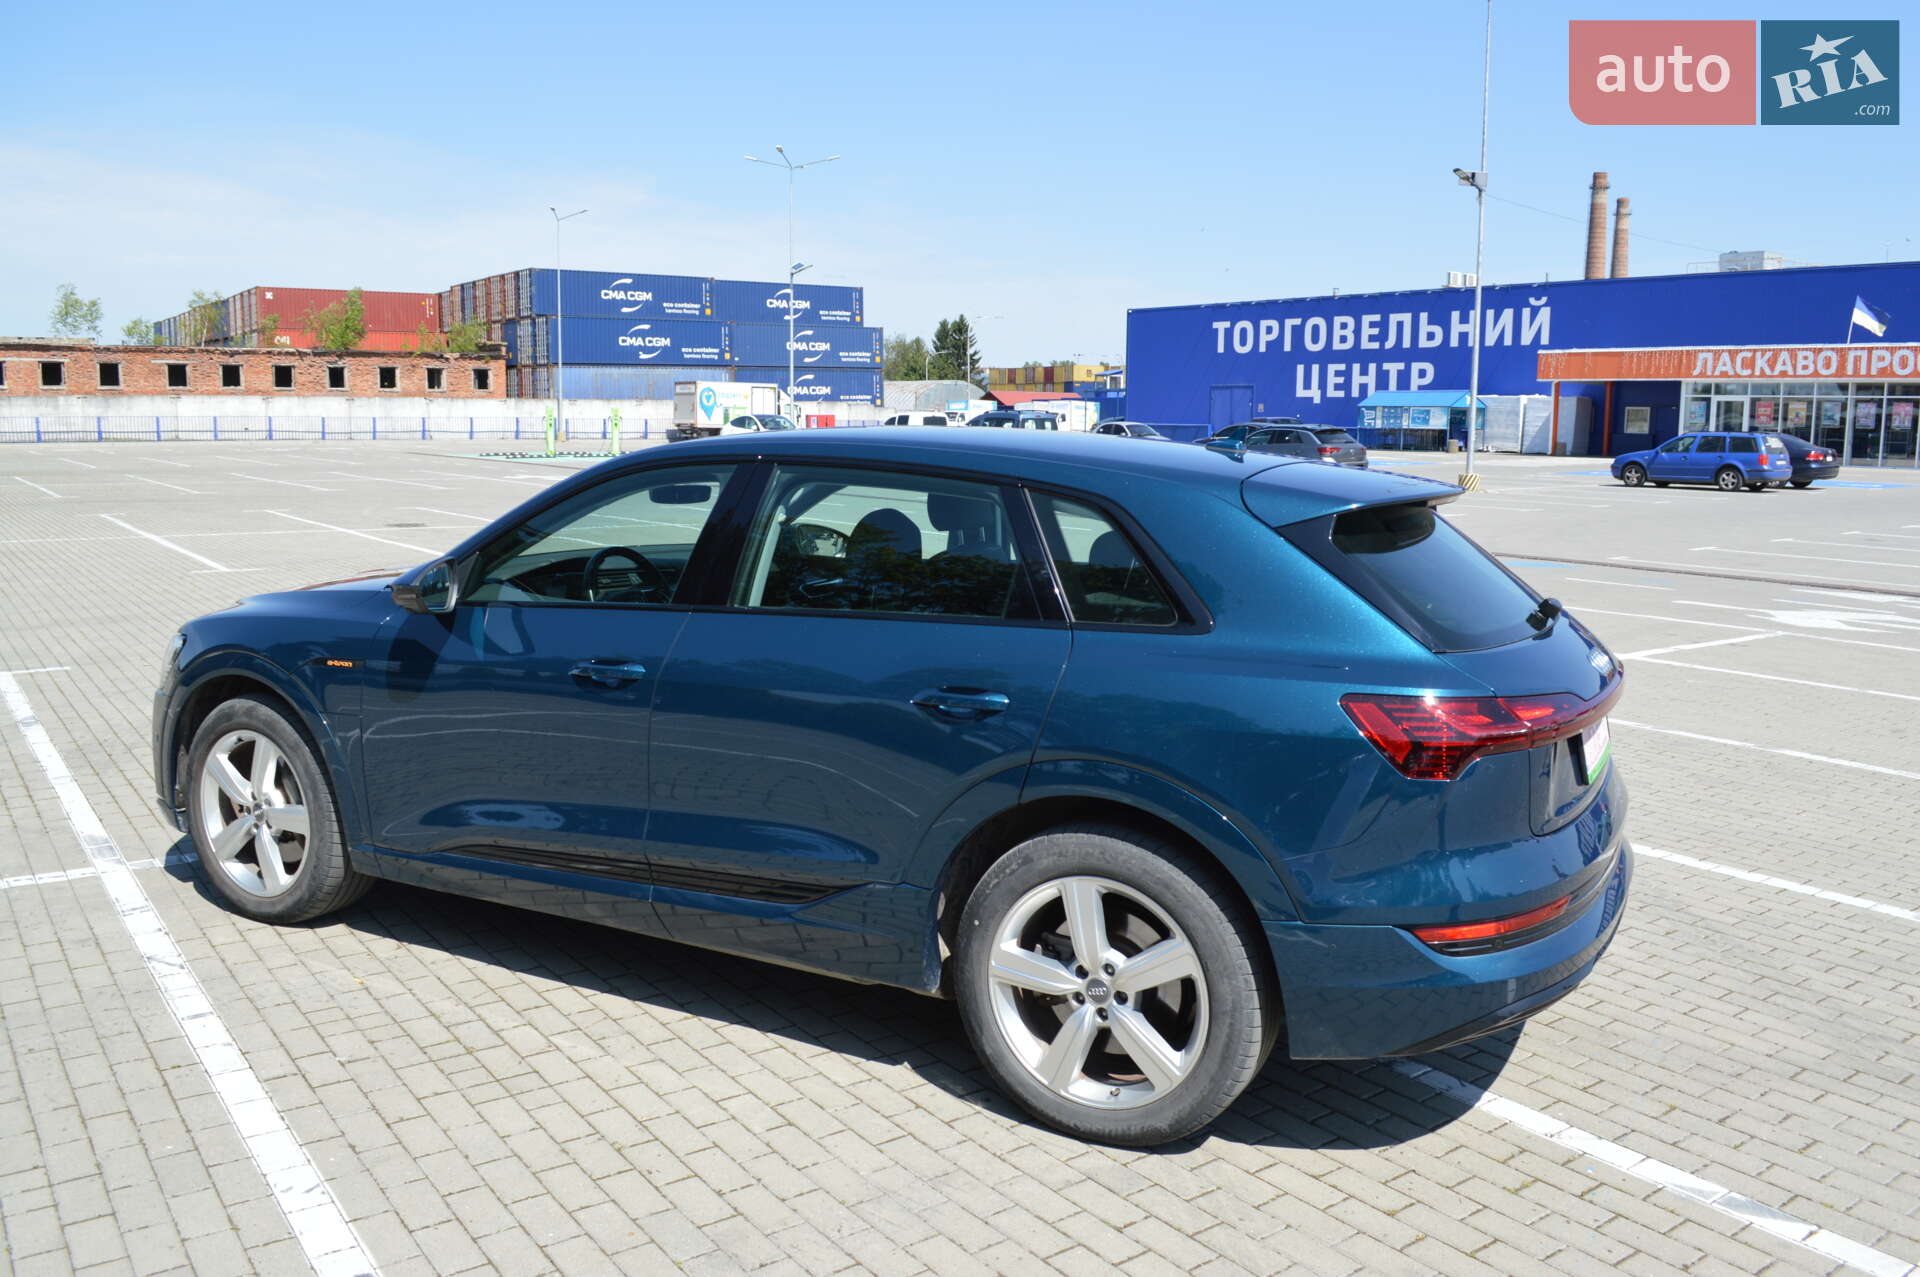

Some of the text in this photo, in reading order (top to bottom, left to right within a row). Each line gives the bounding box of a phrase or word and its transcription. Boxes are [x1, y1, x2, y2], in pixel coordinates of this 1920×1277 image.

[600, 289, 653, 302] CMA CGM
[766, 299, 811, 310] CMA CGM
[1212, 296, 1551, 354] ТОРГОВЕЛЬНИЙ
[618, 336, 671, 348] CMA CGM
[808, 342, 831, 352] CGM
[1692, 349, 1920, 377] ЛАСКАВО ПРО
[1296, 362, 1435, 404] ЦЕНТР
[809, 386, 832, 396] CGM
